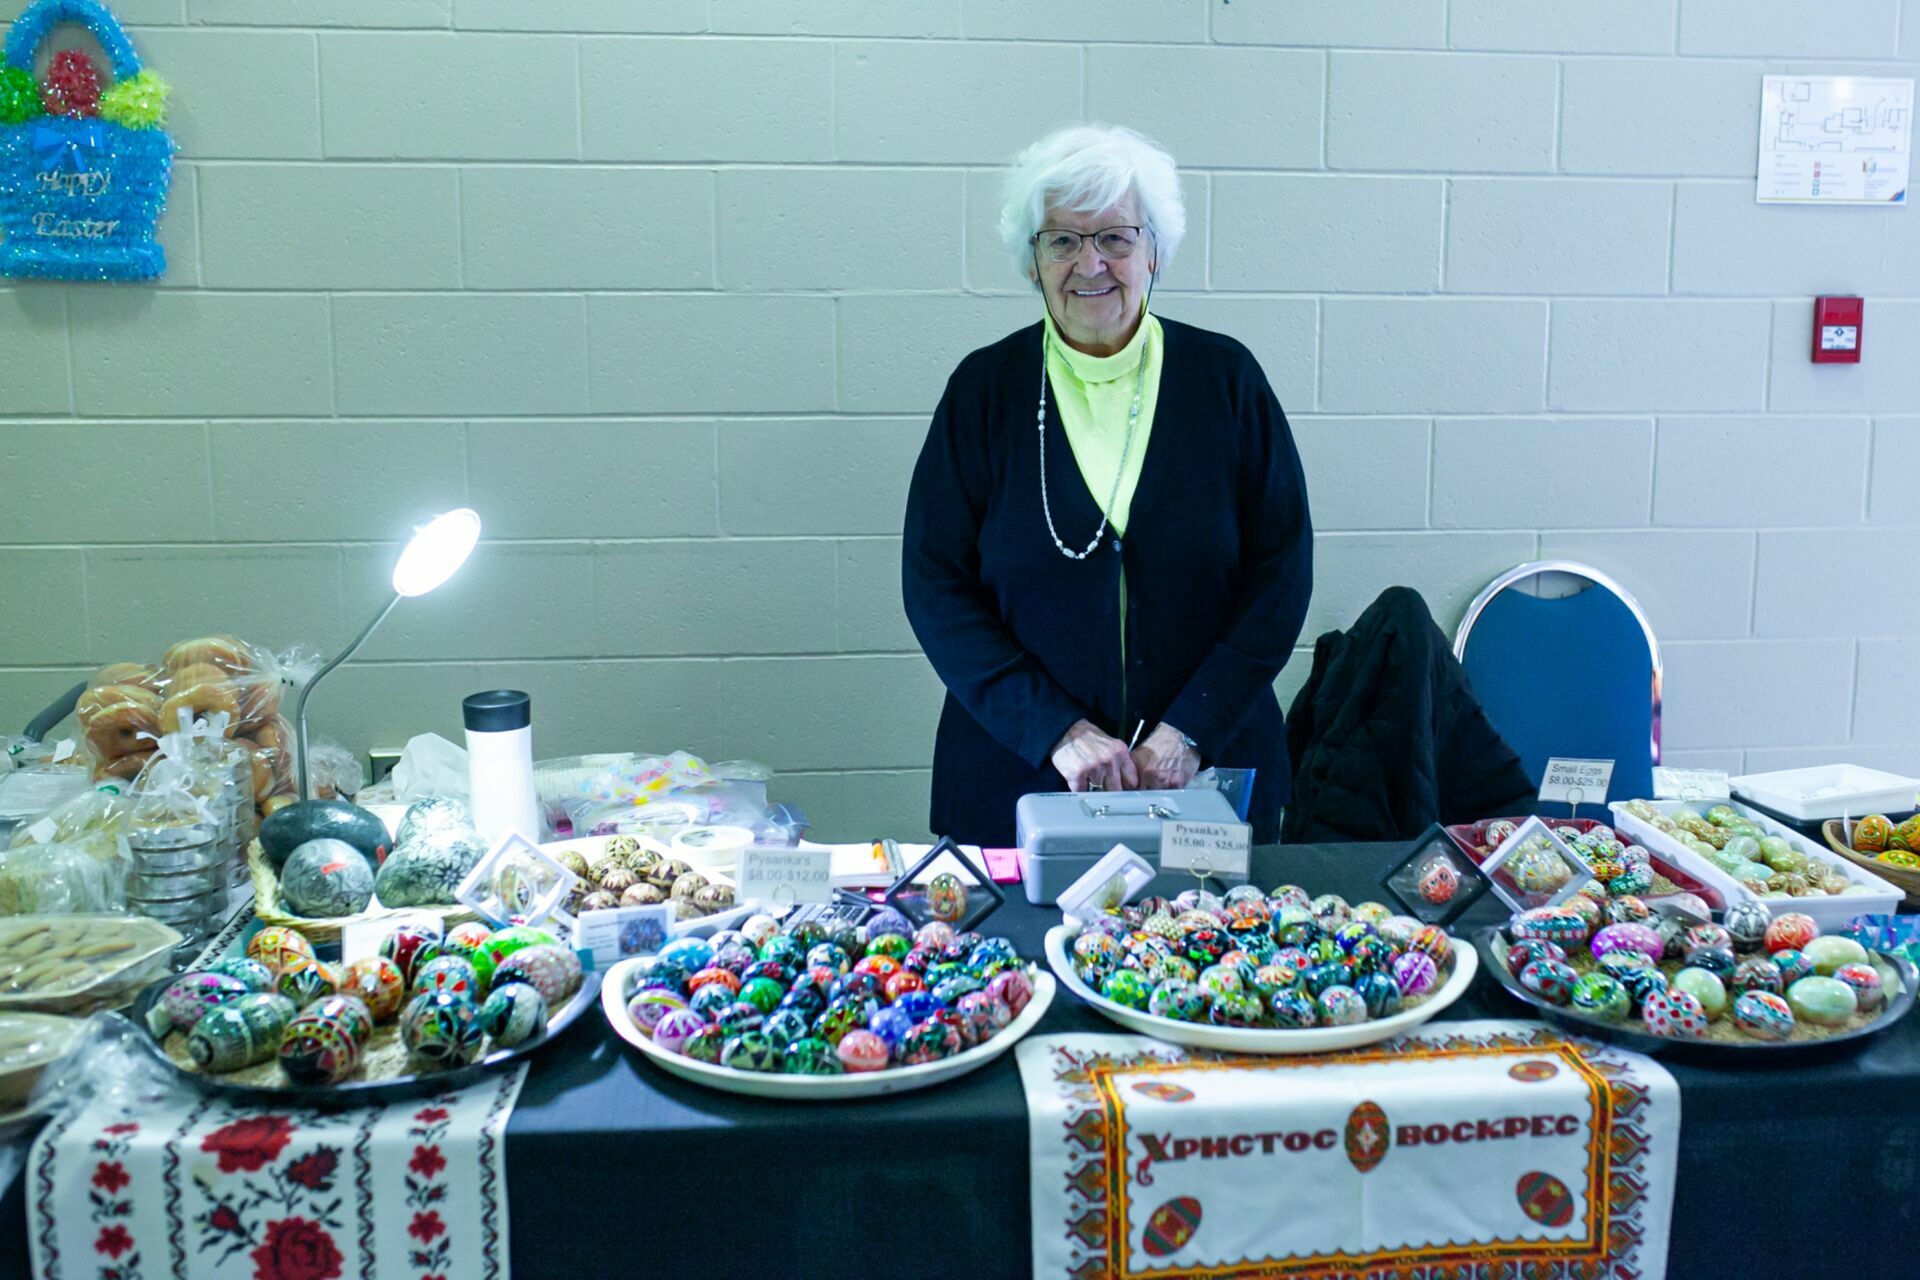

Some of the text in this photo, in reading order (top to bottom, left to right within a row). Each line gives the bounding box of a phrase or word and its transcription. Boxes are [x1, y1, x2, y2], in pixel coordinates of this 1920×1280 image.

[31, 211, 120, 238] Easter
[1551, 763, 1578, 774] Small
[1176, 824, 1228, 837] Pysanka's
[1171, 837, 1205, 848] $15.00
[748, 853, 811, 866] Pysanka's
